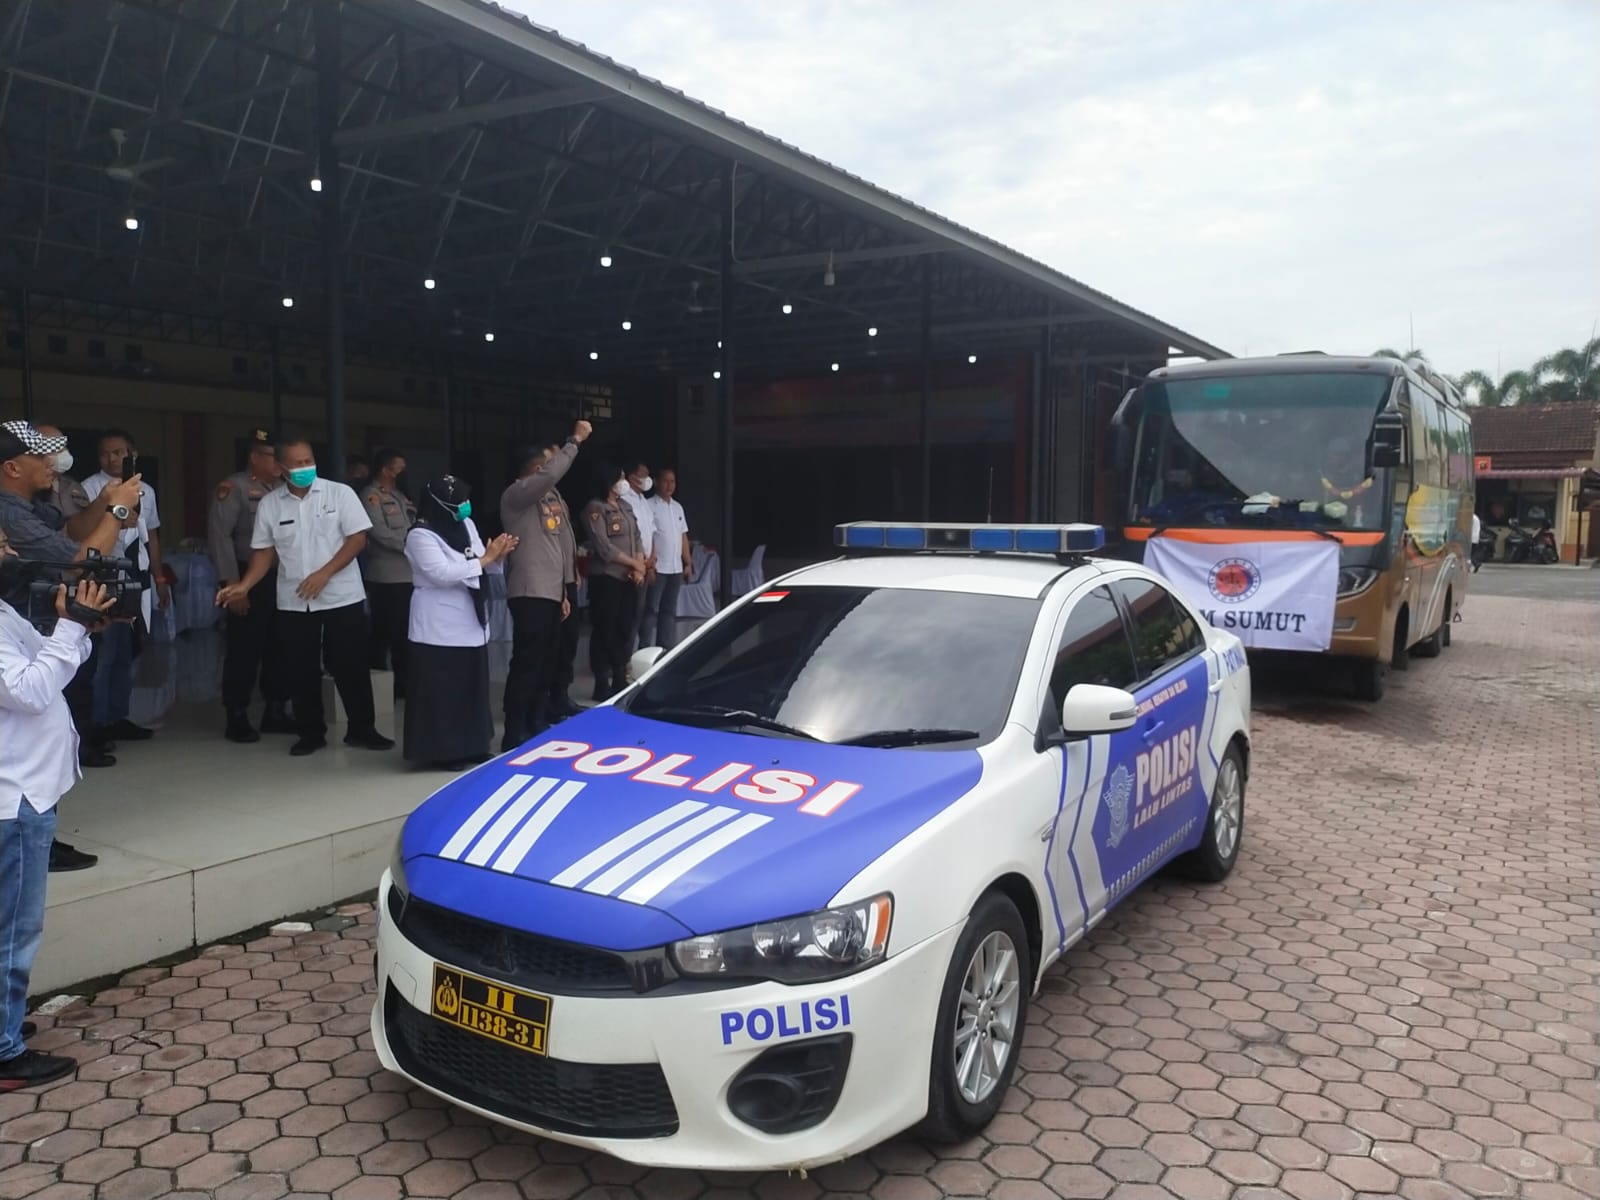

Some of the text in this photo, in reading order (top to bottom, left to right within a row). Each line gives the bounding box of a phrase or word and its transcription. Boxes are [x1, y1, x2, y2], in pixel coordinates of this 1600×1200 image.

[1224, 611, 1306, 632] SUMUT
[508, 741, 863, 817] POLISI
[1136, 725, 1196, 807] POLISI
[1134, 775, 1193, 829] LALU LINTAS
[486, 986, 516, 1014] II
[720, 994, 850, 1045] POLISI
[461, 1004, 542, 1049] 1138-31
